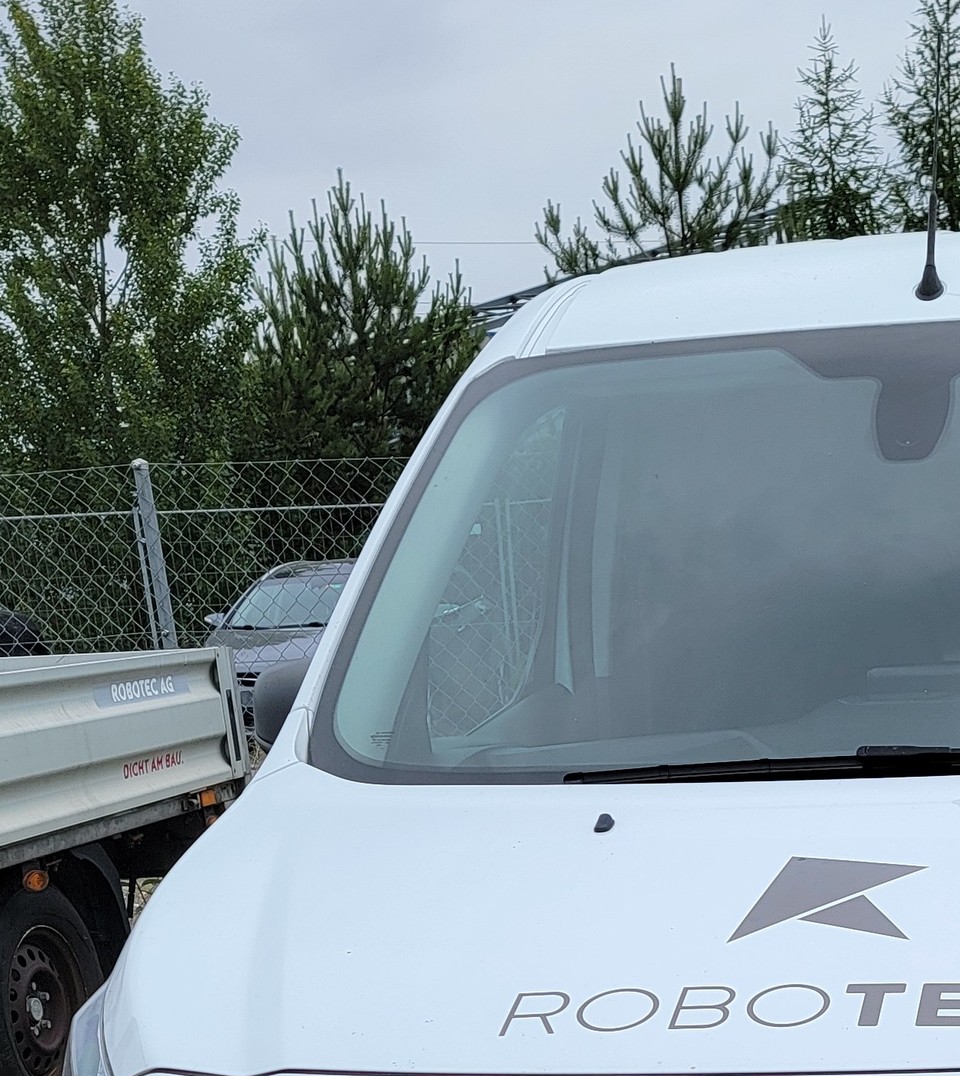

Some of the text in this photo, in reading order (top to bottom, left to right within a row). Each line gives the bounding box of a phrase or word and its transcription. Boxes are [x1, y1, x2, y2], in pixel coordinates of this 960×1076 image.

[111, 675, 175, 702] ROBOTEC AG
[123, 758, 149, 779] DICHT
[151, 755, 163, 772] AM
